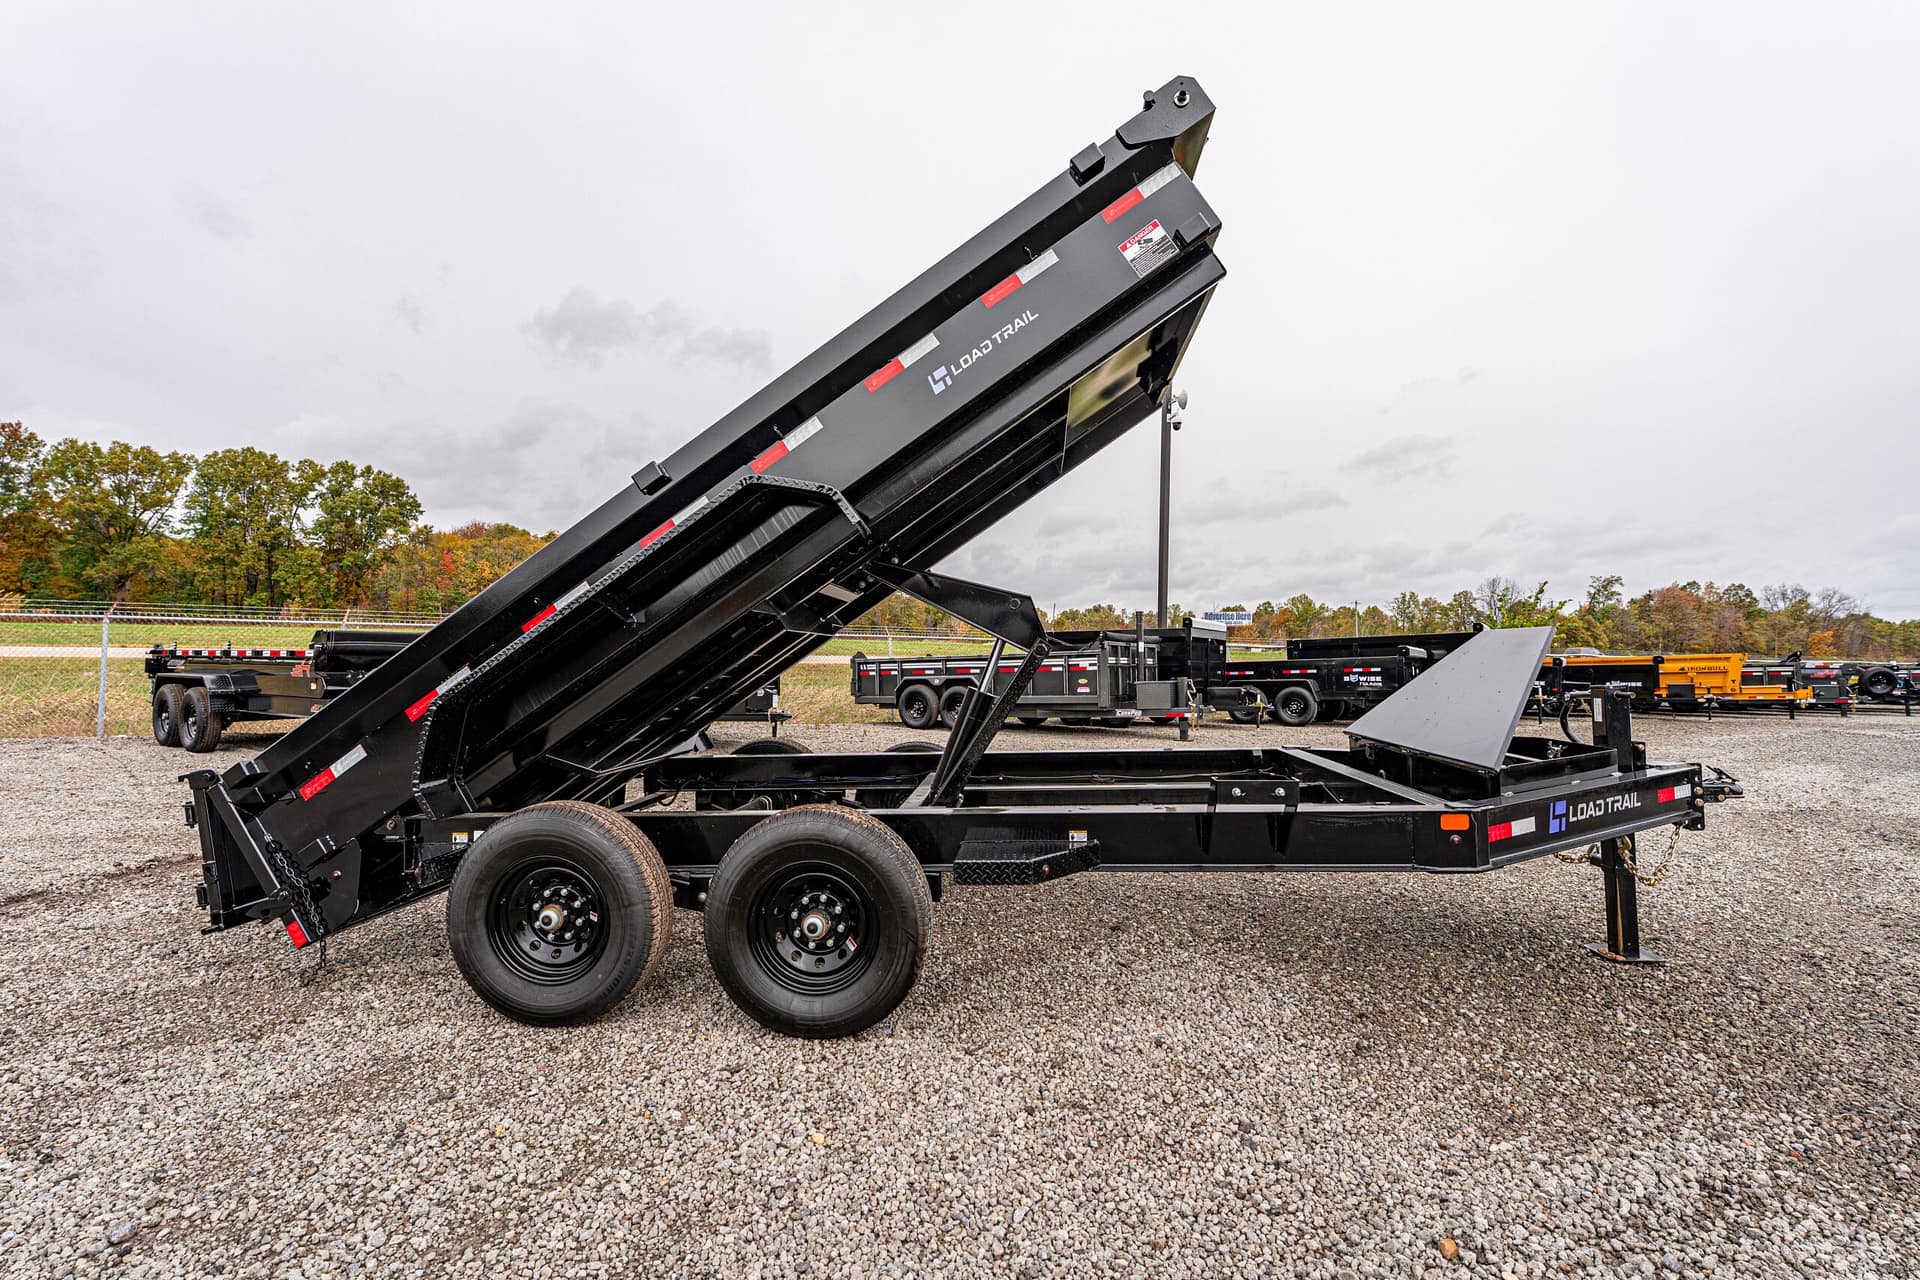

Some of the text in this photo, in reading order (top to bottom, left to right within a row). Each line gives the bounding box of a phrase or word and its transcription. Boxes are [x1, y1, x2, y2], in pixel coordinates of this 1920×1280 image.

[1129, 225, 1154, 244] DANGER
[950, 310, 1039, 376] LOAD TRAIL
[1569, 792, 1642, 822] LOAD TRAIL
